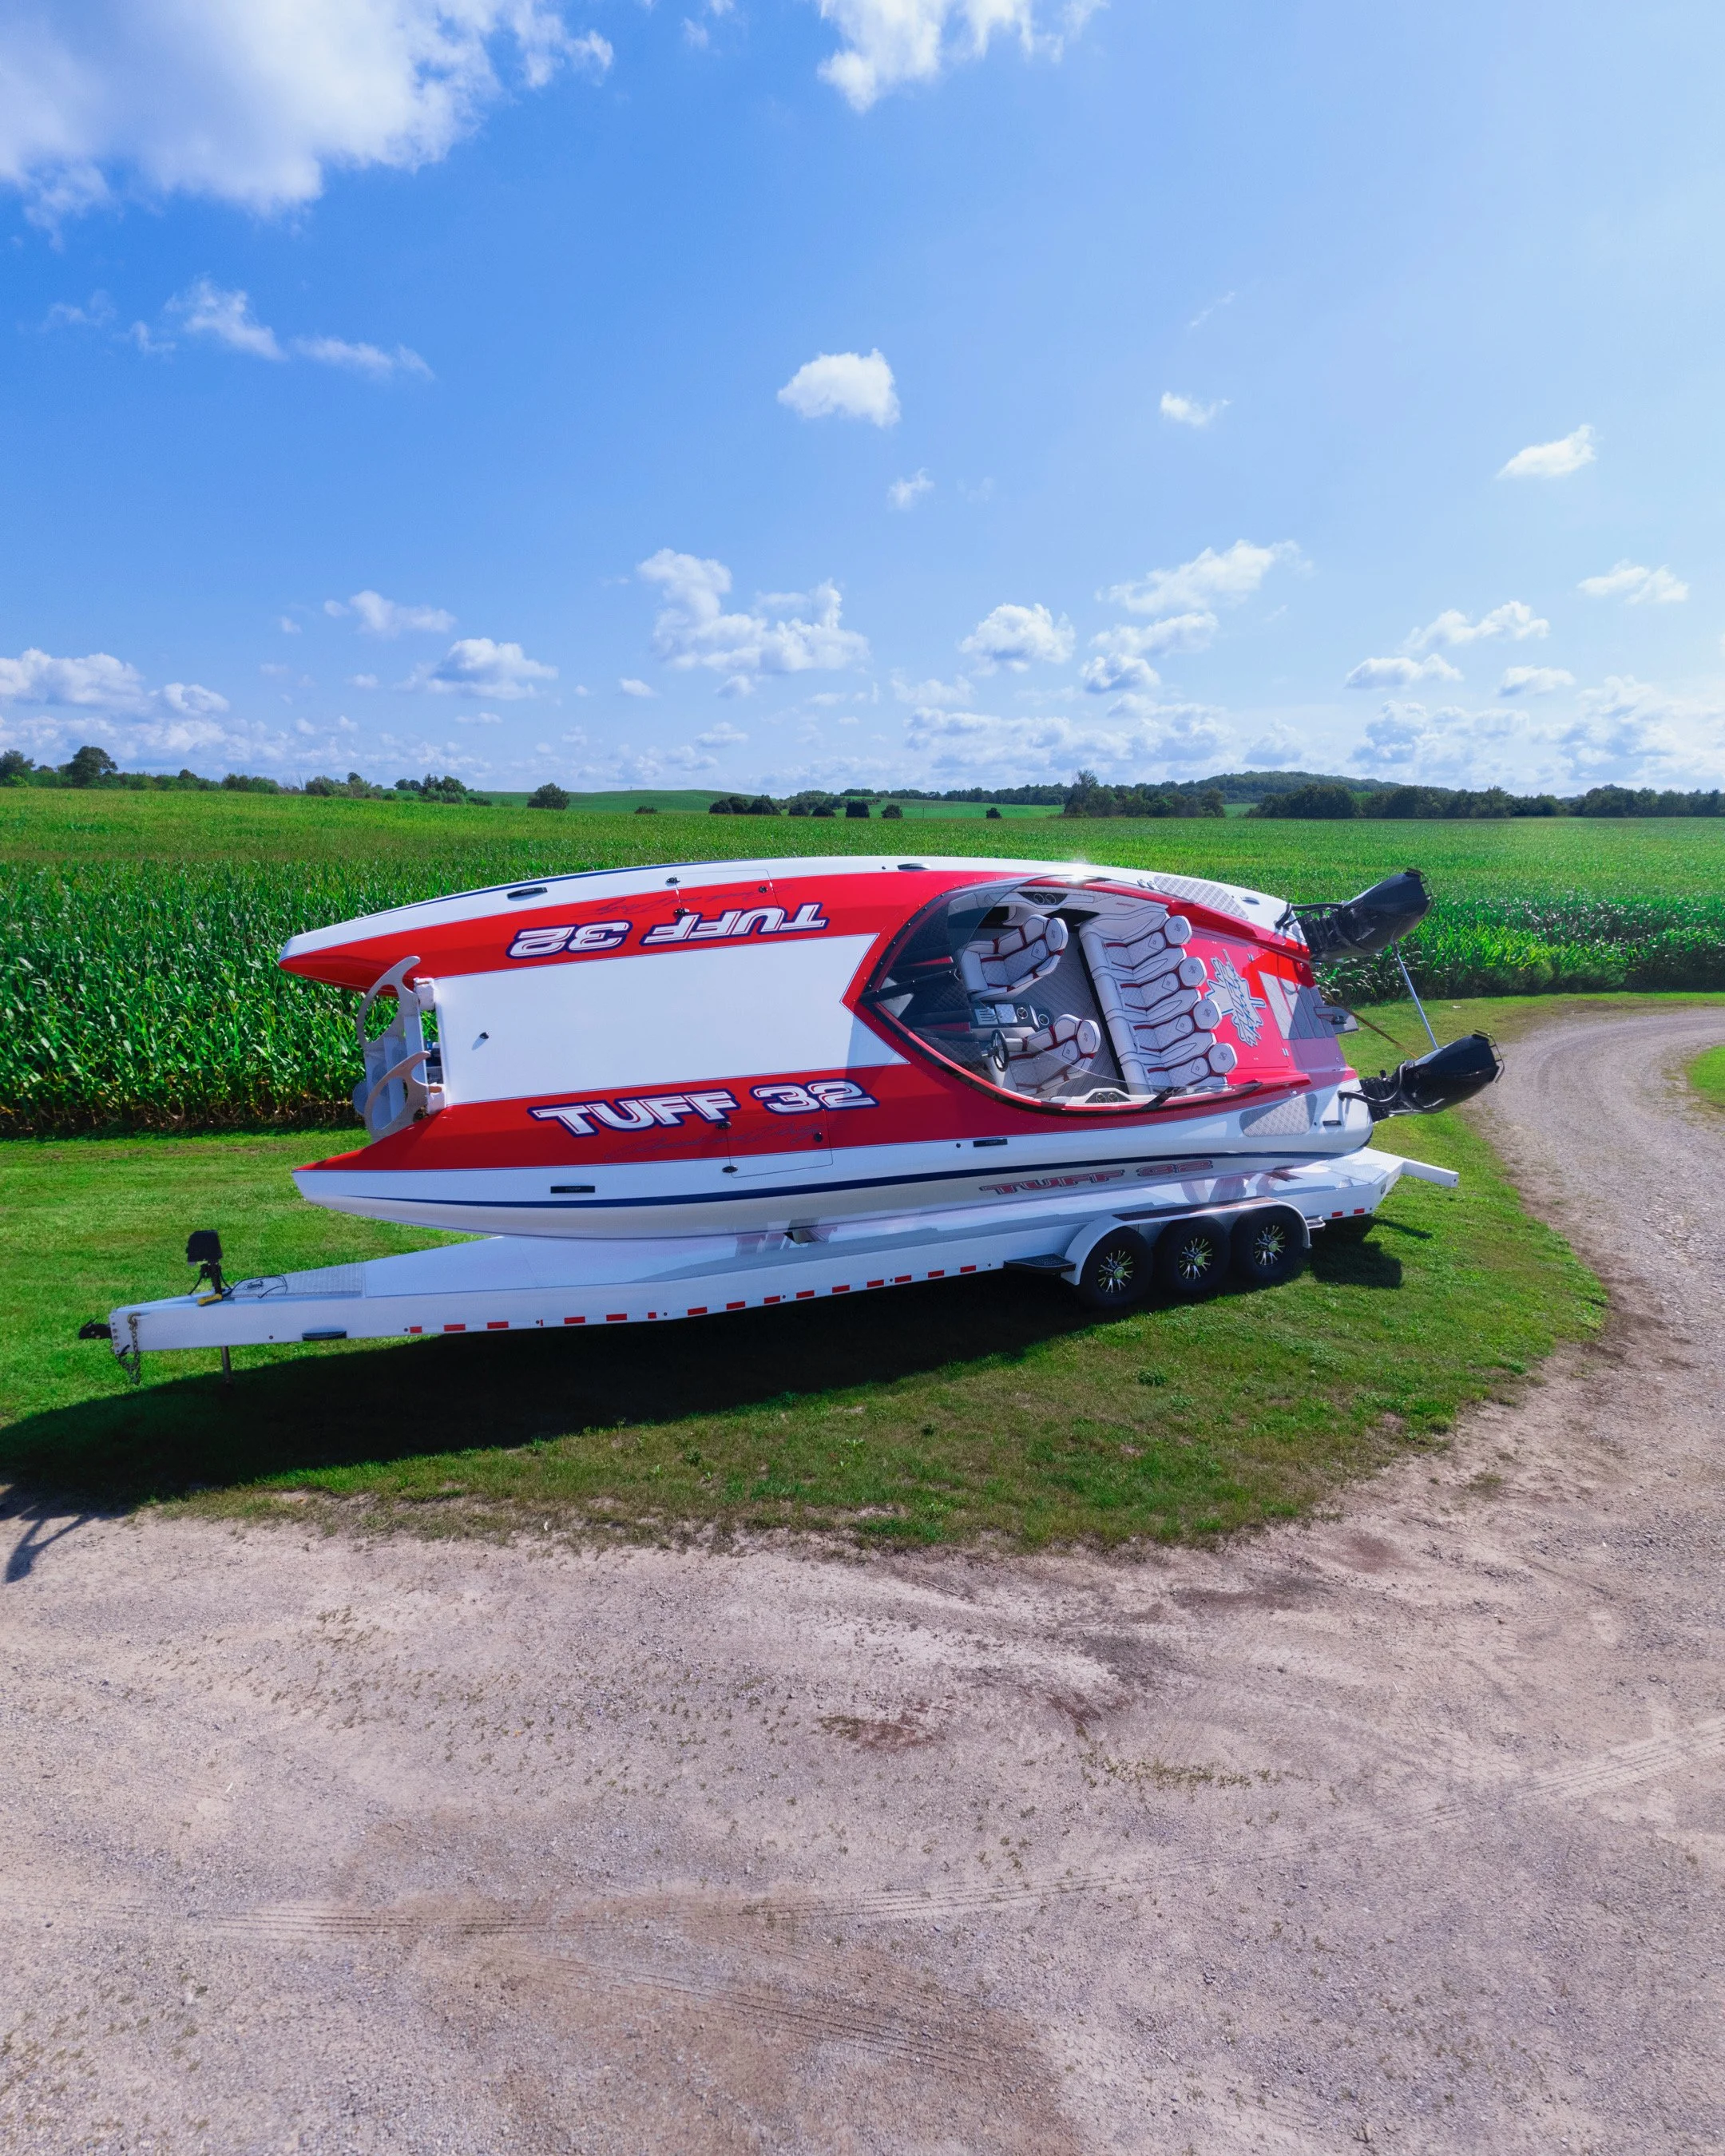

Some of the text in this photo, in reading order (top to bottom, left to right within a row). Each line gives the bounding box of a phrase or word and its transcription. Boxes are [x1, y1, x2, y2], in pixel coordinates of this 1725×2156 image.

[506, 902, 829, 958] TUFF 32
[528, 1078, 879, 1137] TUFF 32
[979, 1160, 1213, 1195] TUFF 32
